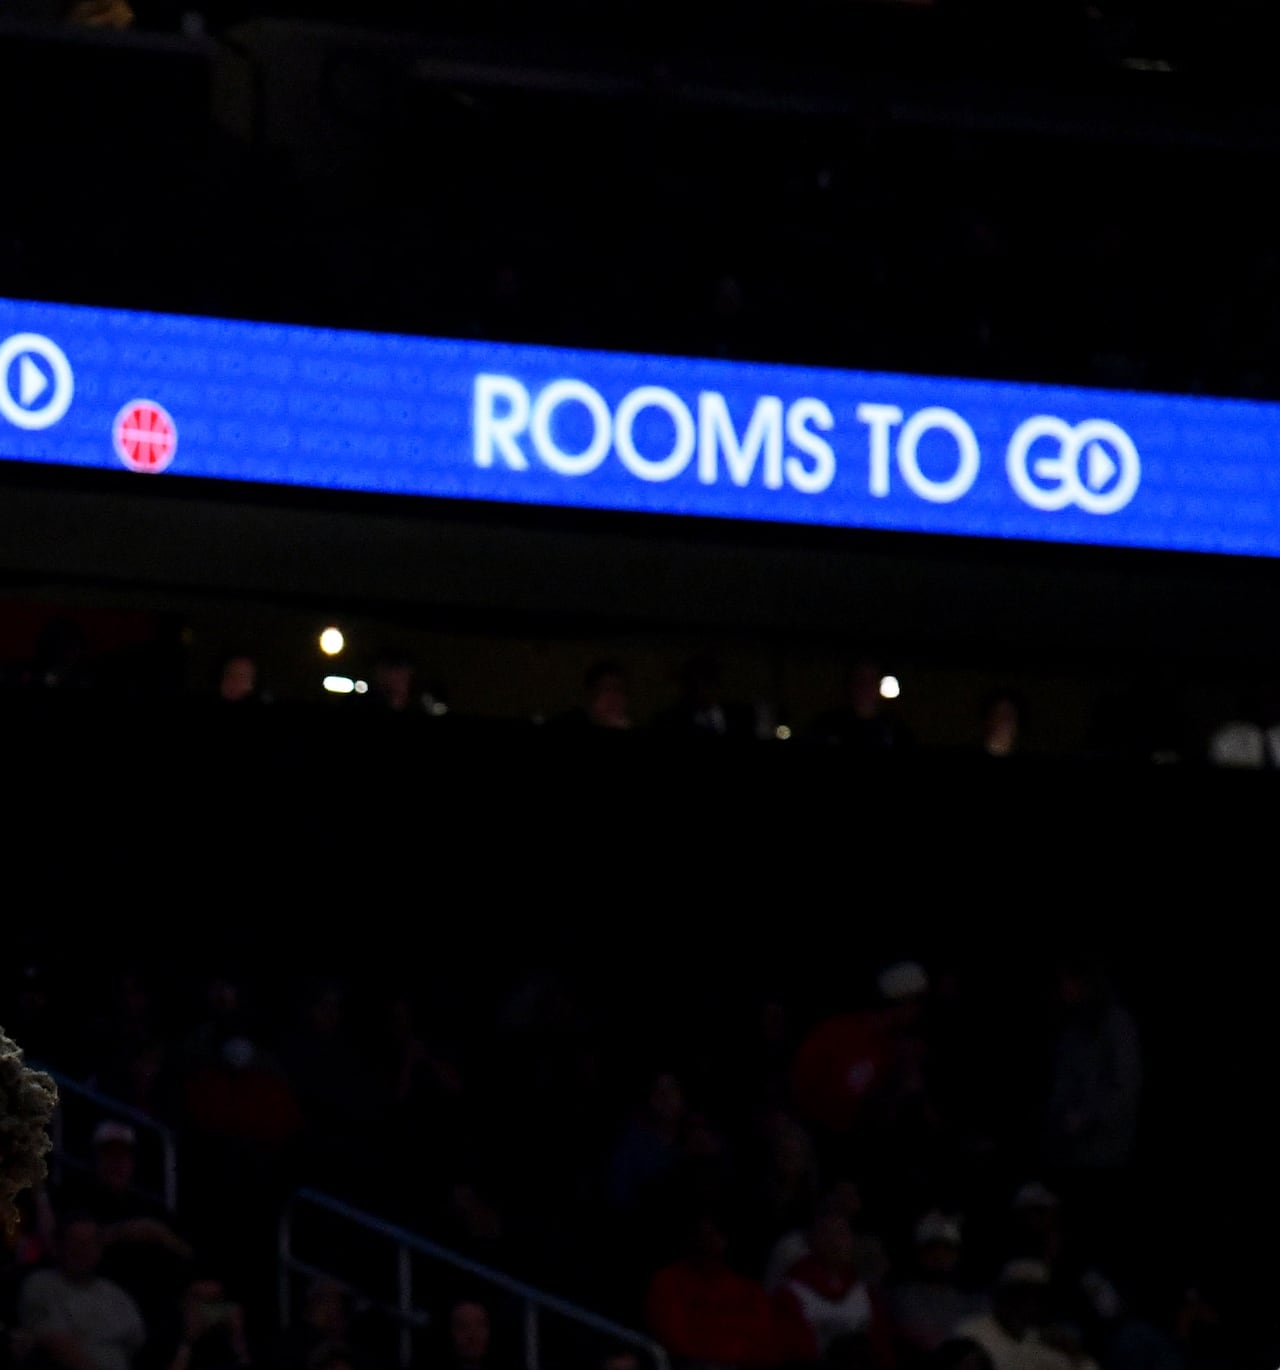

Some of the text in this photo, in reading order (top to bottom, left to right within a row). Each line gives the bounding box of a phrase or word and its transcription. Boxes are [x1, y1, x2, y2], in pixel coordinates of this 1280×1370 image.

[475, 375, 834, 492] ROOMS
[859, 405, 978, 501] TO
[1008, 417, 1139, 513] GO
